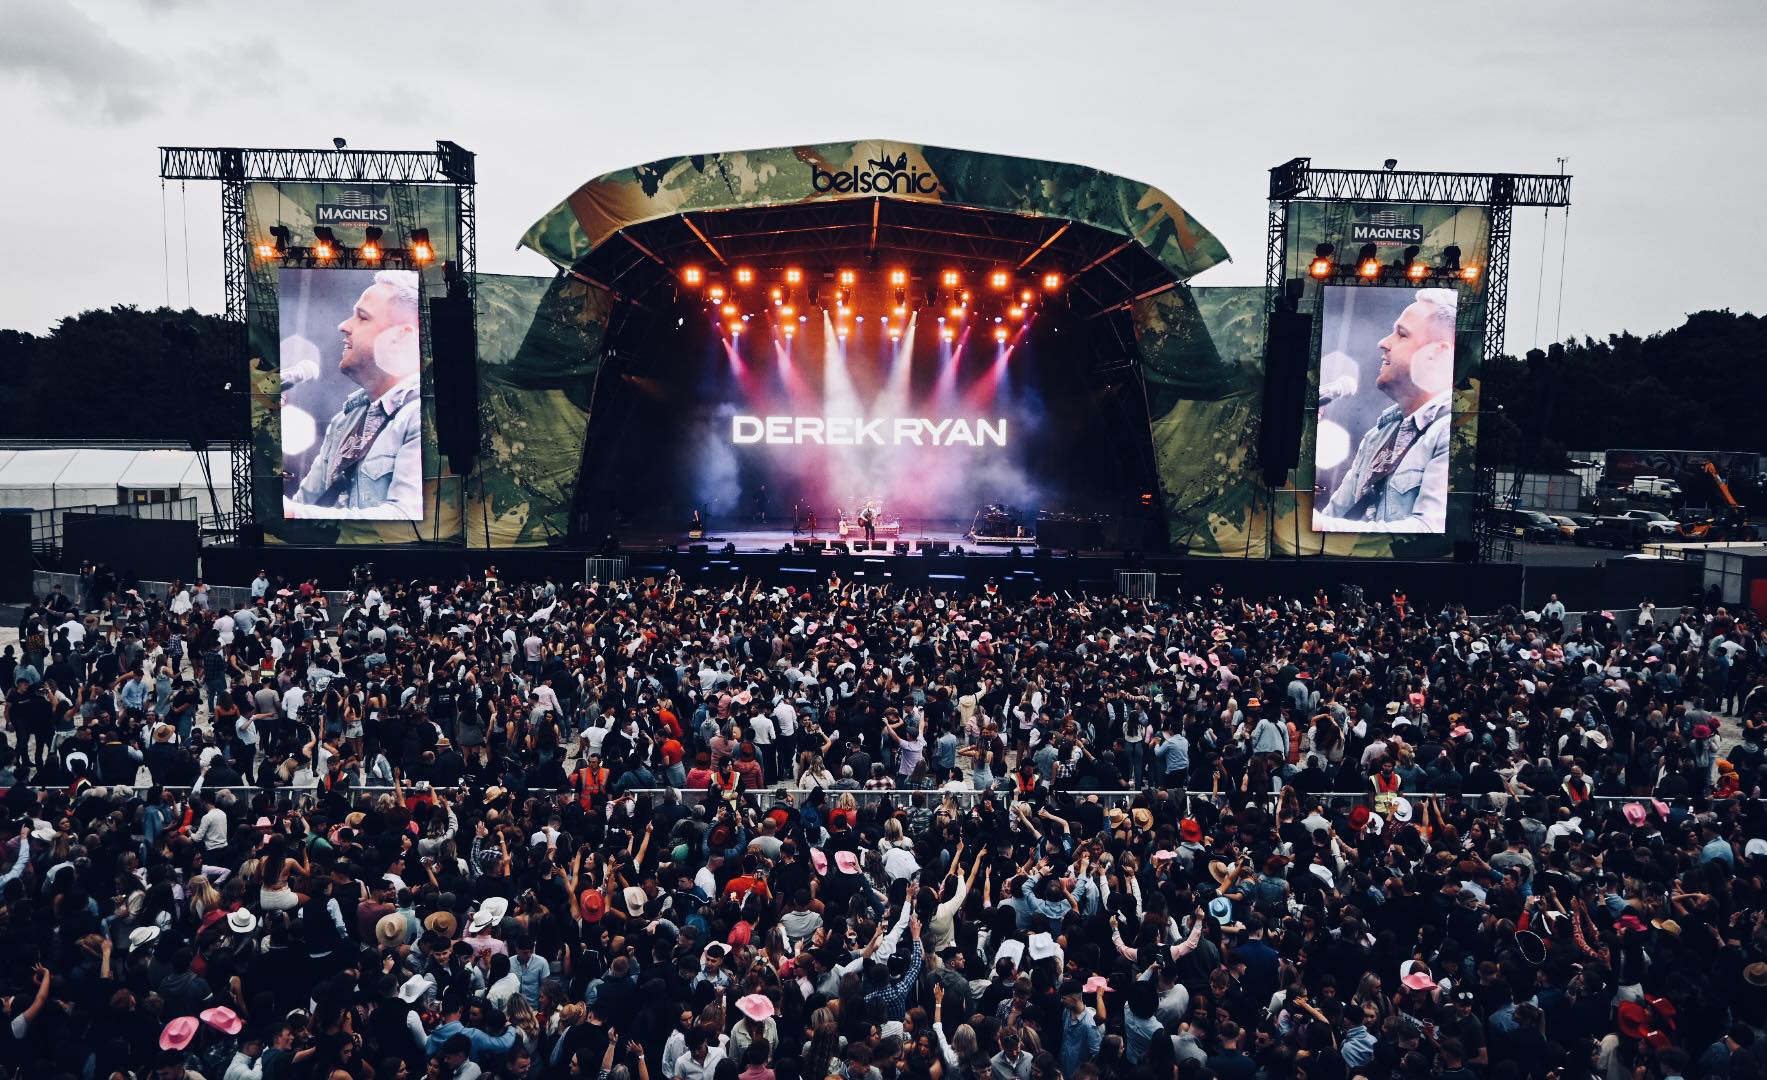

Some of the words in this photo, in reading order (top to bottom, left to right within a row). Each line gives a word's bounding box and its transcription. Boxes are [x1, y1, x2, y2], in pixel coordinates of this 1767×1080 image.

[812, 164, 938, 194] belsonic
[319, 207, 388, 221] MAGNERS
[1354, 226, 1421, 240] MAGNERS
[732, 415, 885, 446] DEREK
[893, 418, 1007, 447] RYAN
